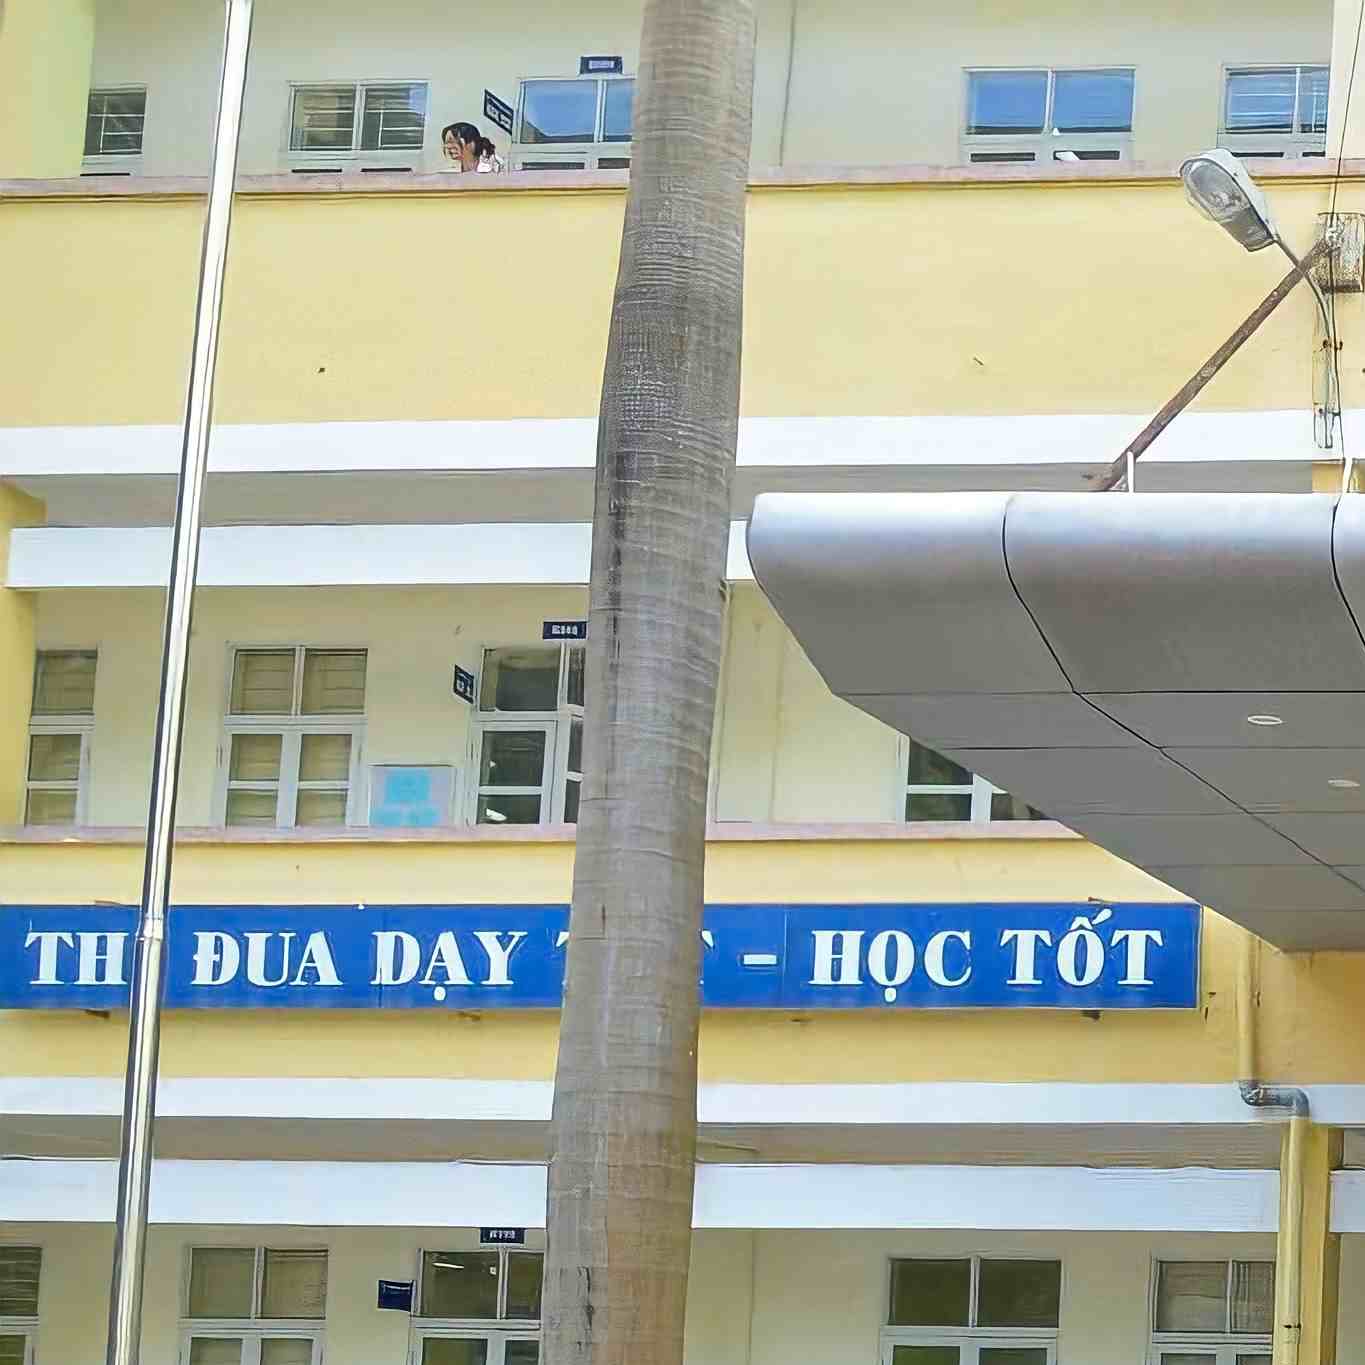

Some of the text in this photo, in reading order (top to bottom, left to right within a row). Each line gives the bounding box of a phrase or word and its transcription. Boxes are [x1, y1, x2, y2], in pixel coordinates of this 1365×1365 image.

[25, 930, 131, 986] TH
[192, 929, 341, 986] ĐUA
[370, 930, 528, 1001] DẠY
[811, 929, 971, 1002] HỌC
[1001, 909, 1163, 987] TỐT
